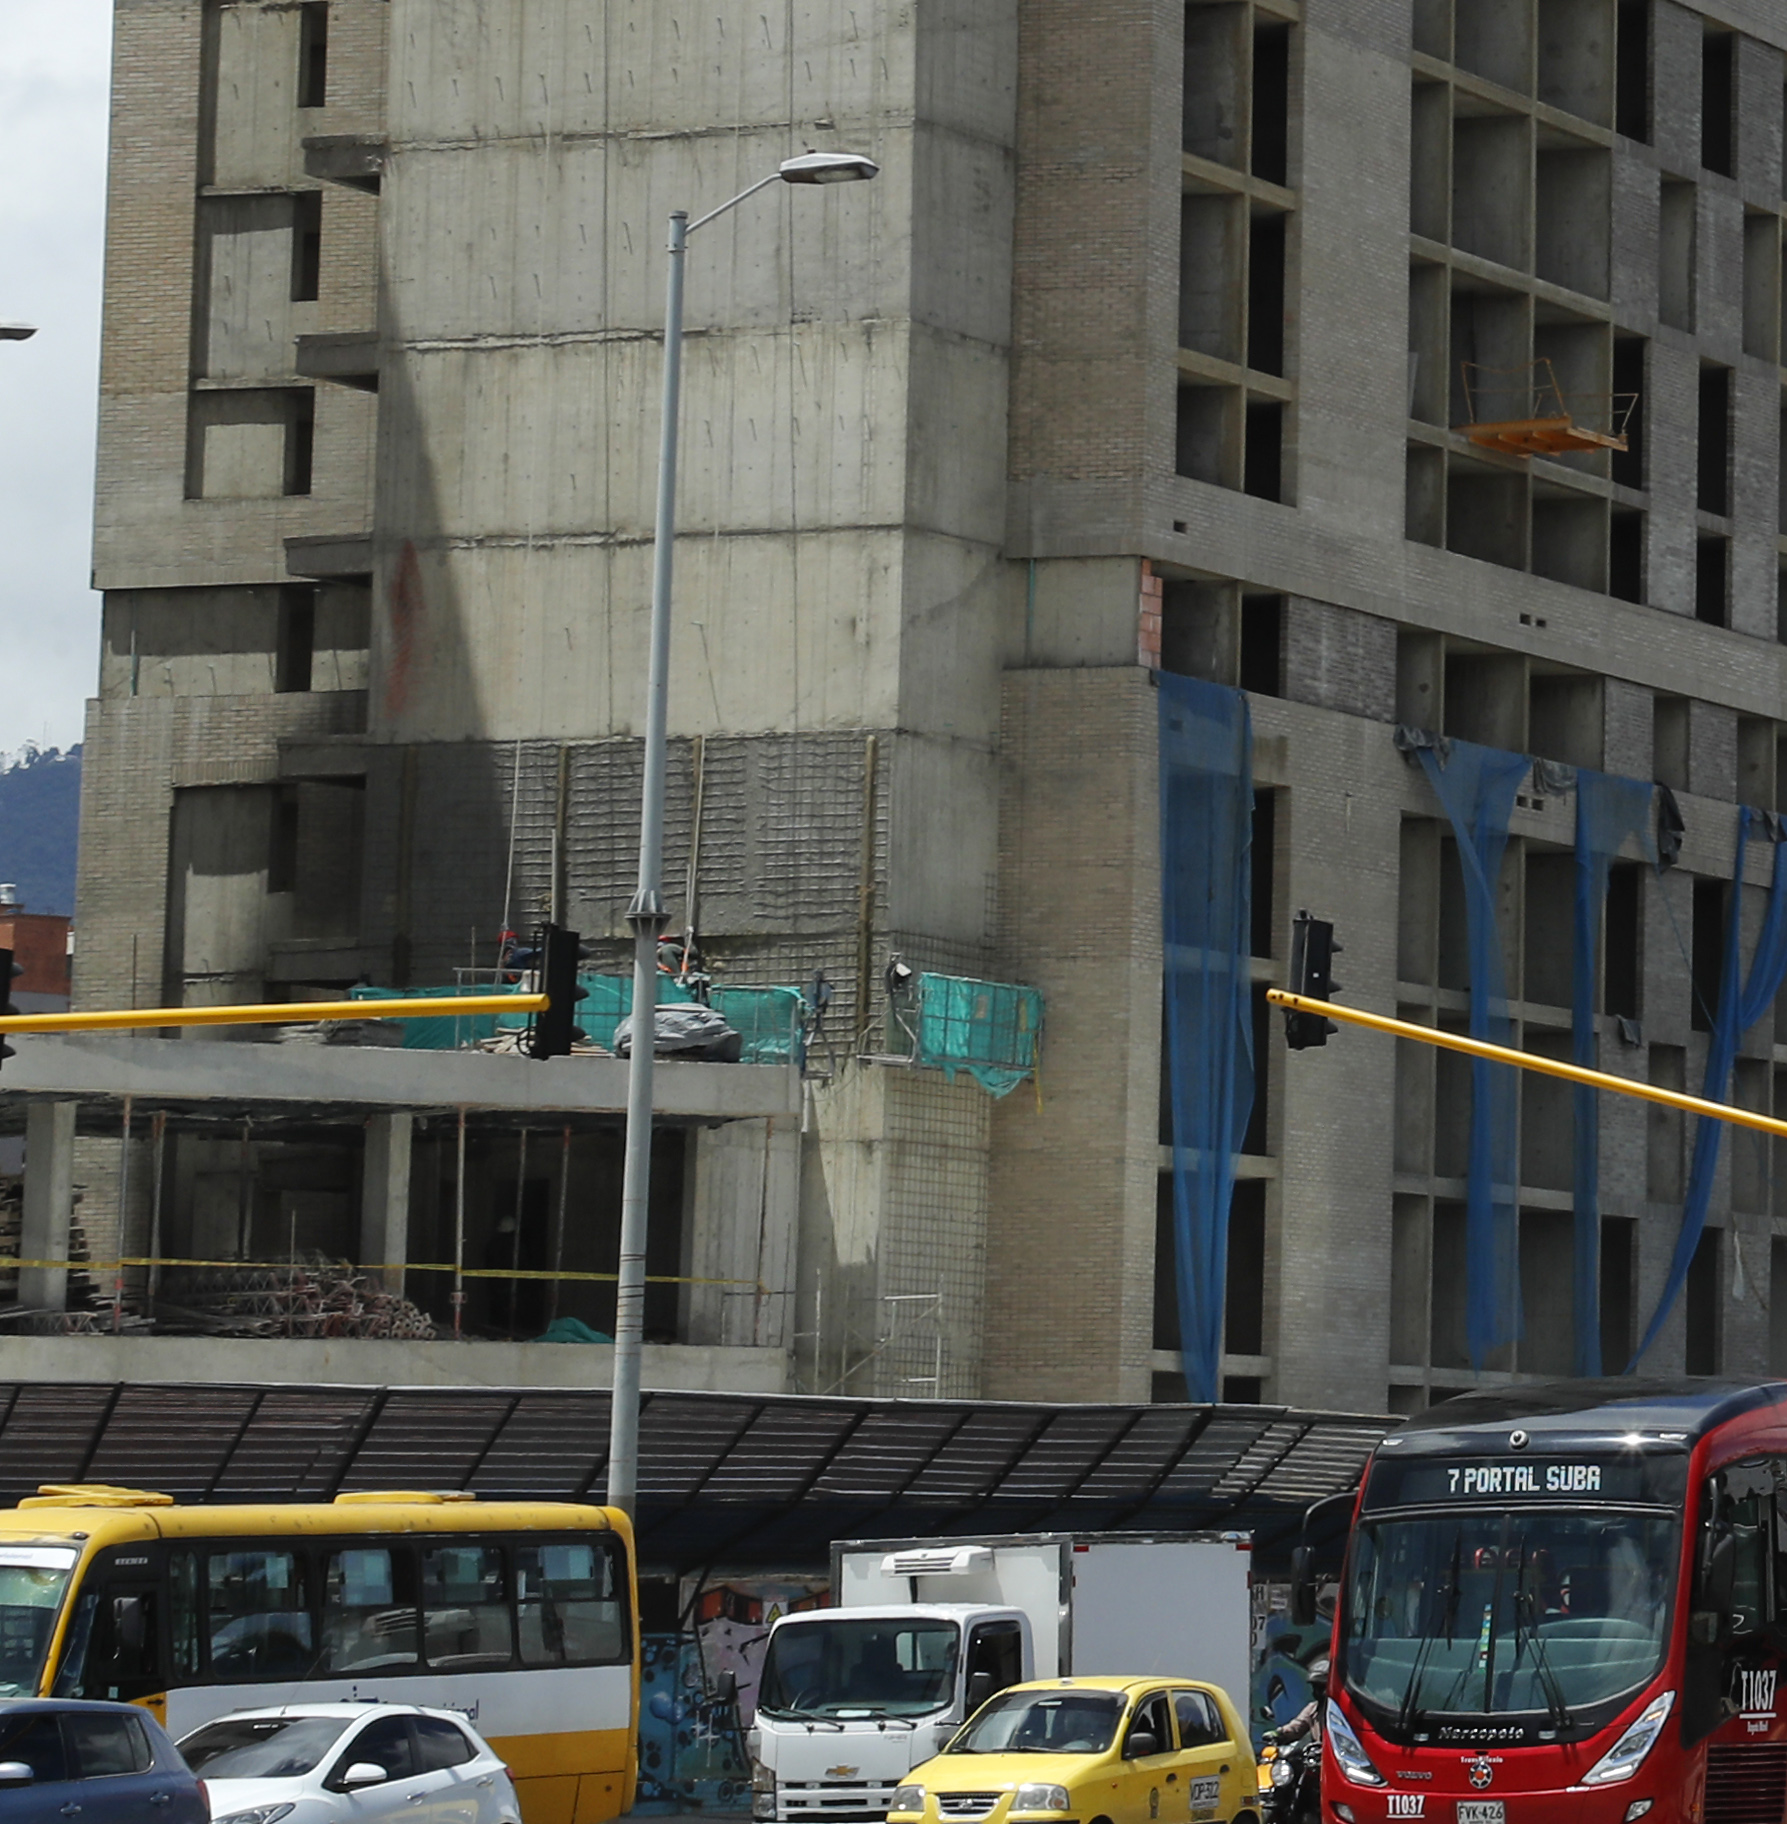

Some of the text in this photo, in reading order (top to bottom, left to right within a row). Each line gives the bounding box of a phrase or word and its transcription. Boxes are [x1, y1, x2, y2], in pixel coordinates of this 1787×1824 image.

[1448, 1465, 1601, 1494] 7 PORTAL SUBA
[1741, 1670, 1777, 1711] T1037
[1387, 1794, 1426, 1815] T1037
